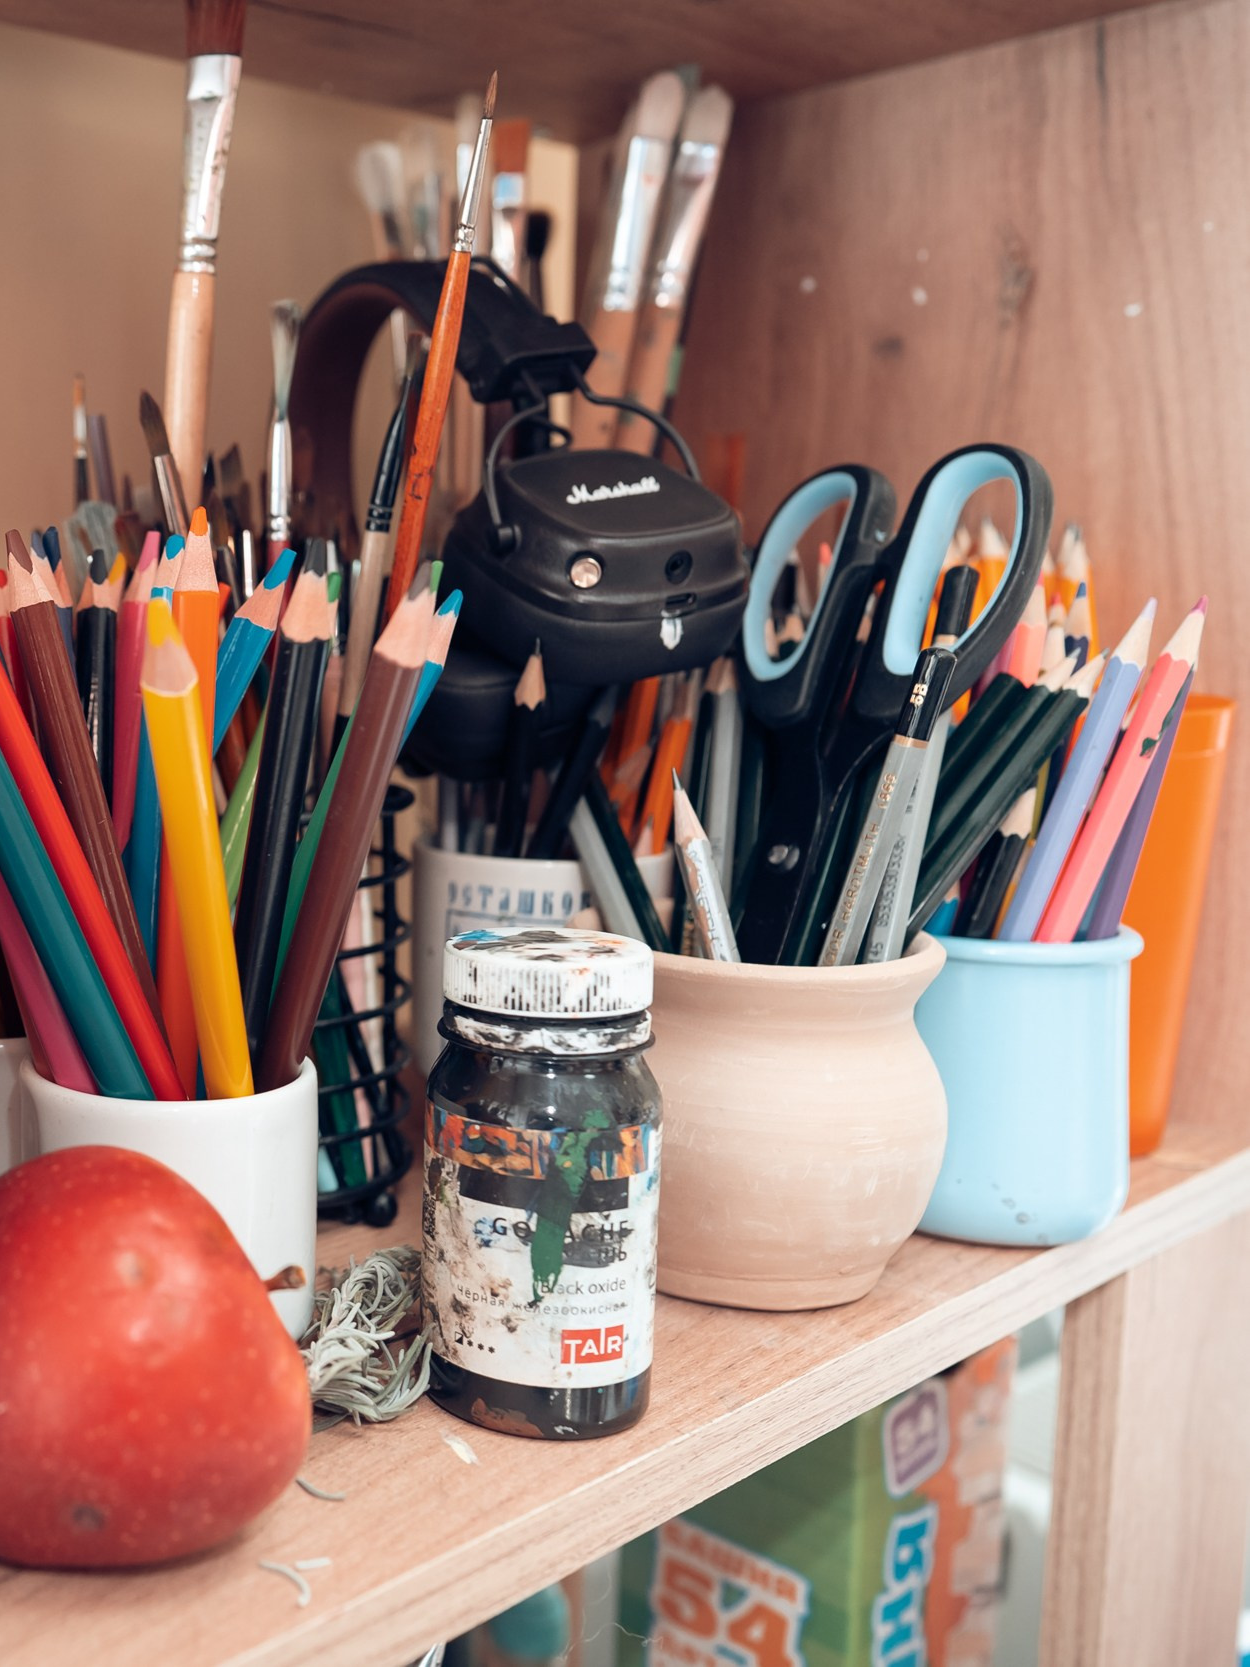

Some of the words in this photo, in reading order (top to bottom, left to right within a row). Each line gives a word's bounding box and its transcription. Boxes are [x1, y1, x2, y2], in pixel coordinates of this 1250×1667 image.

[566, 475, 661, 505] Marshall
[492, 1216, 631, 1242] GOACHE
[588, 1277, 627, 1295] oxide
[563, 1327, 623, 1364] TAIR
